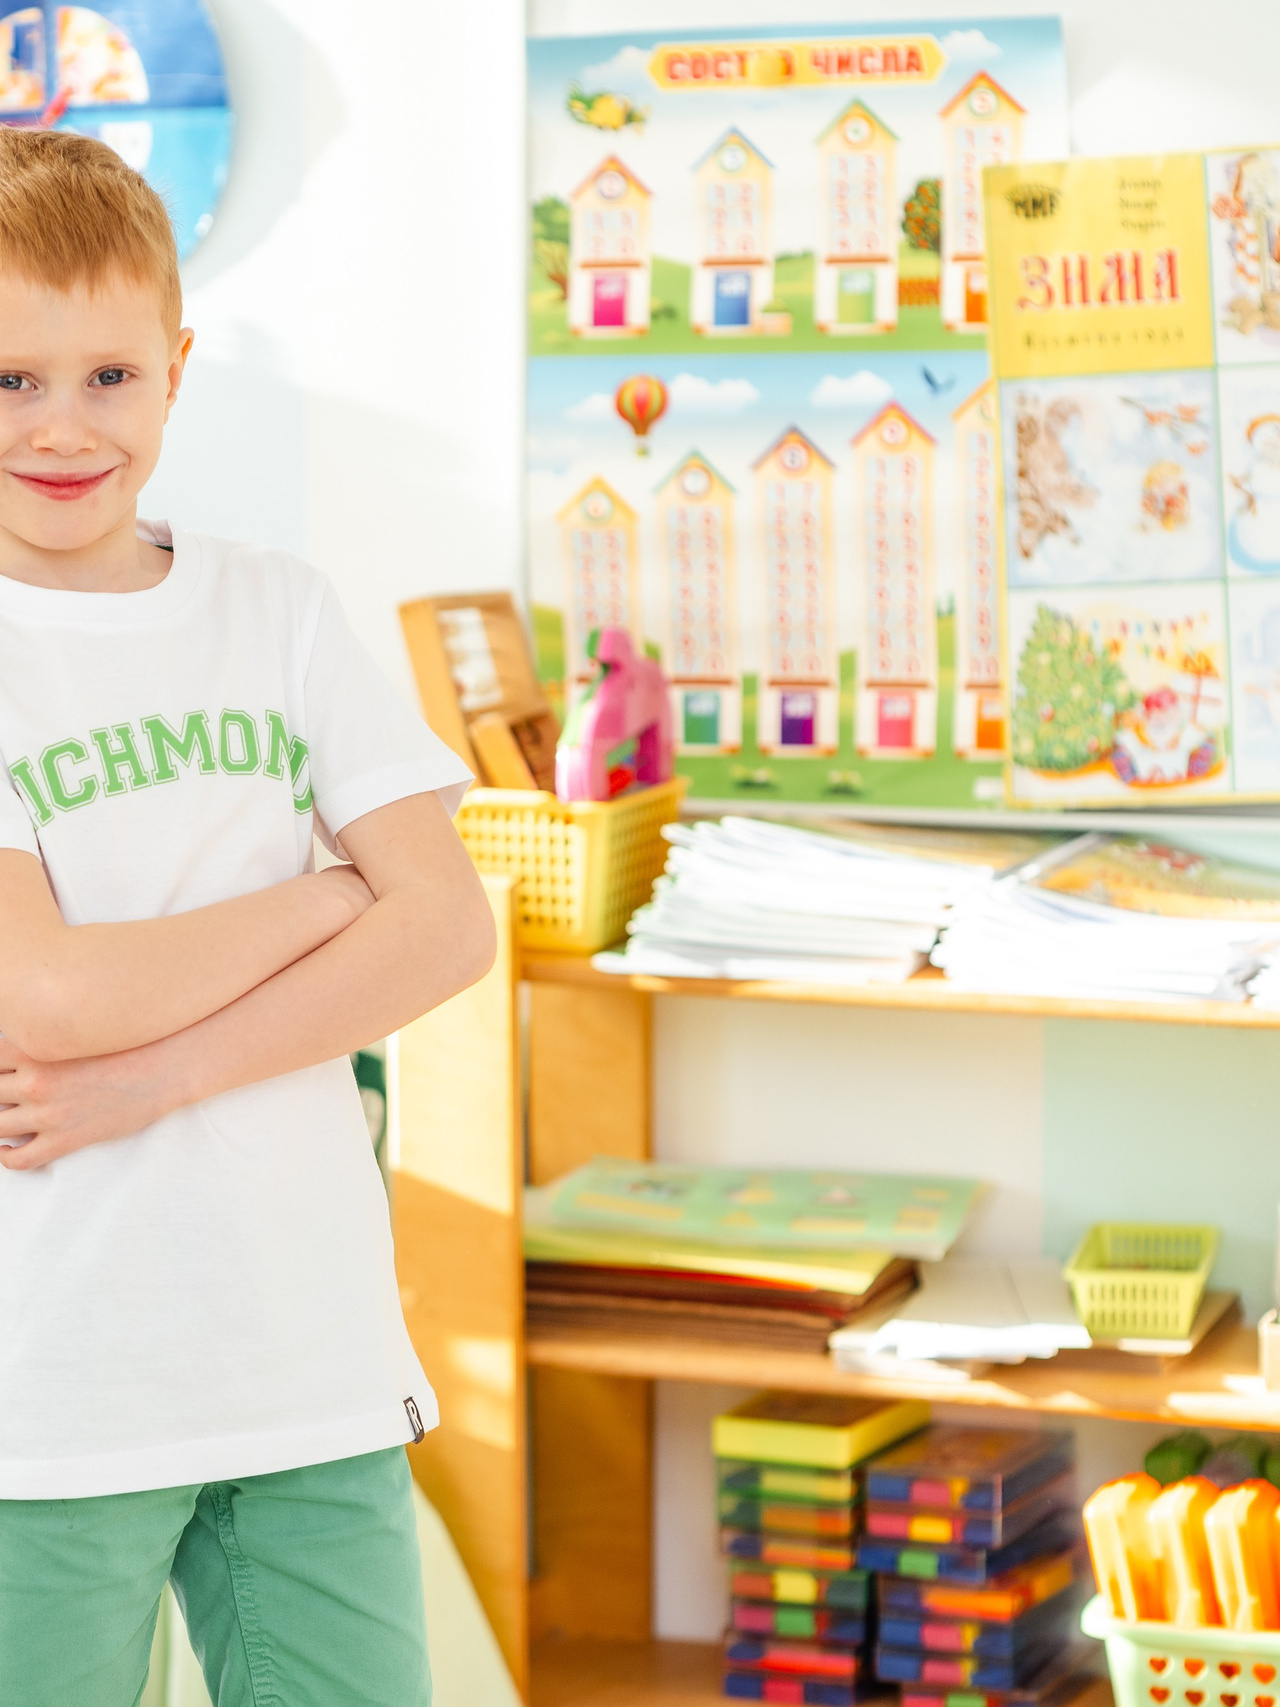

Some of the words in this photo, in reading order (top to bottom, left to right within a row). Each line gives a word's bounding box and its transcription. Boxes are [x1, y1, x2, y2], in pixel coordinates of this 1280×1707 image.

[666, 52, 794, 80] СОСТВ
[811, 45, 924, 75] ЧИСЛА
[1017, 248, 1181, 310] ЗИМА
[7, 707, 313, 830] ICHMON
